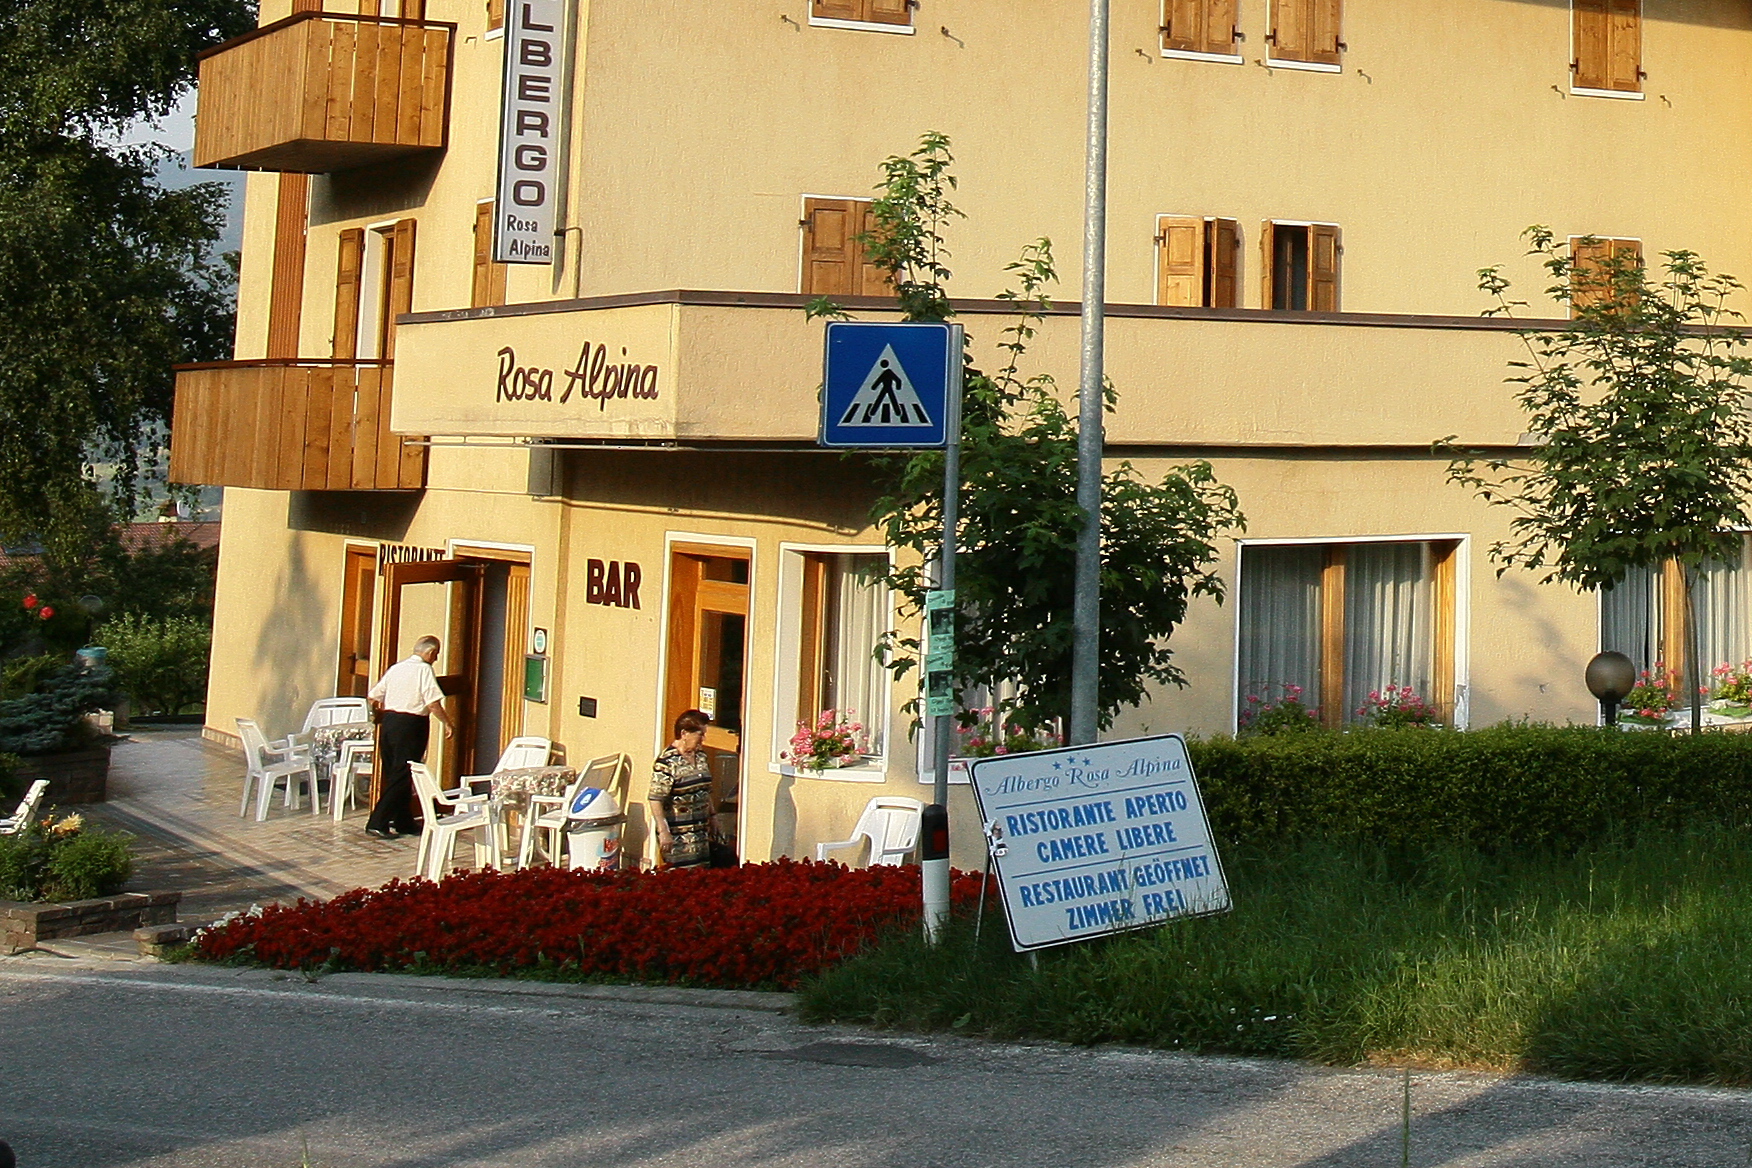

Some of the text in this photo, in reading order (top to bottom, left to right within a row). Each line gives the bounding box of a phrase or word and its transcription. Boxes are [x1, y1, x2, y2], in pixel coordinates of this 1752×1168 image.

[507, 215, 538, 233] Rosa
[509, 238, 550, 260] Alpina
[497, 341, 659, 412] Rosa Alpina
[586, 558, 642, 610] BAR
[985, 757, 1181, 797] Albergo Rosa Alpina
[1006, 790, 1188, 837] RISTORANTE APERTO
[1037, 821, 1178, 863] CAMERE LIBERE
[1020, 854, 1211, 908] RESTAURANT GEÖFFNET
[1066, 888, 1187, 930] ZIMMER FREI
